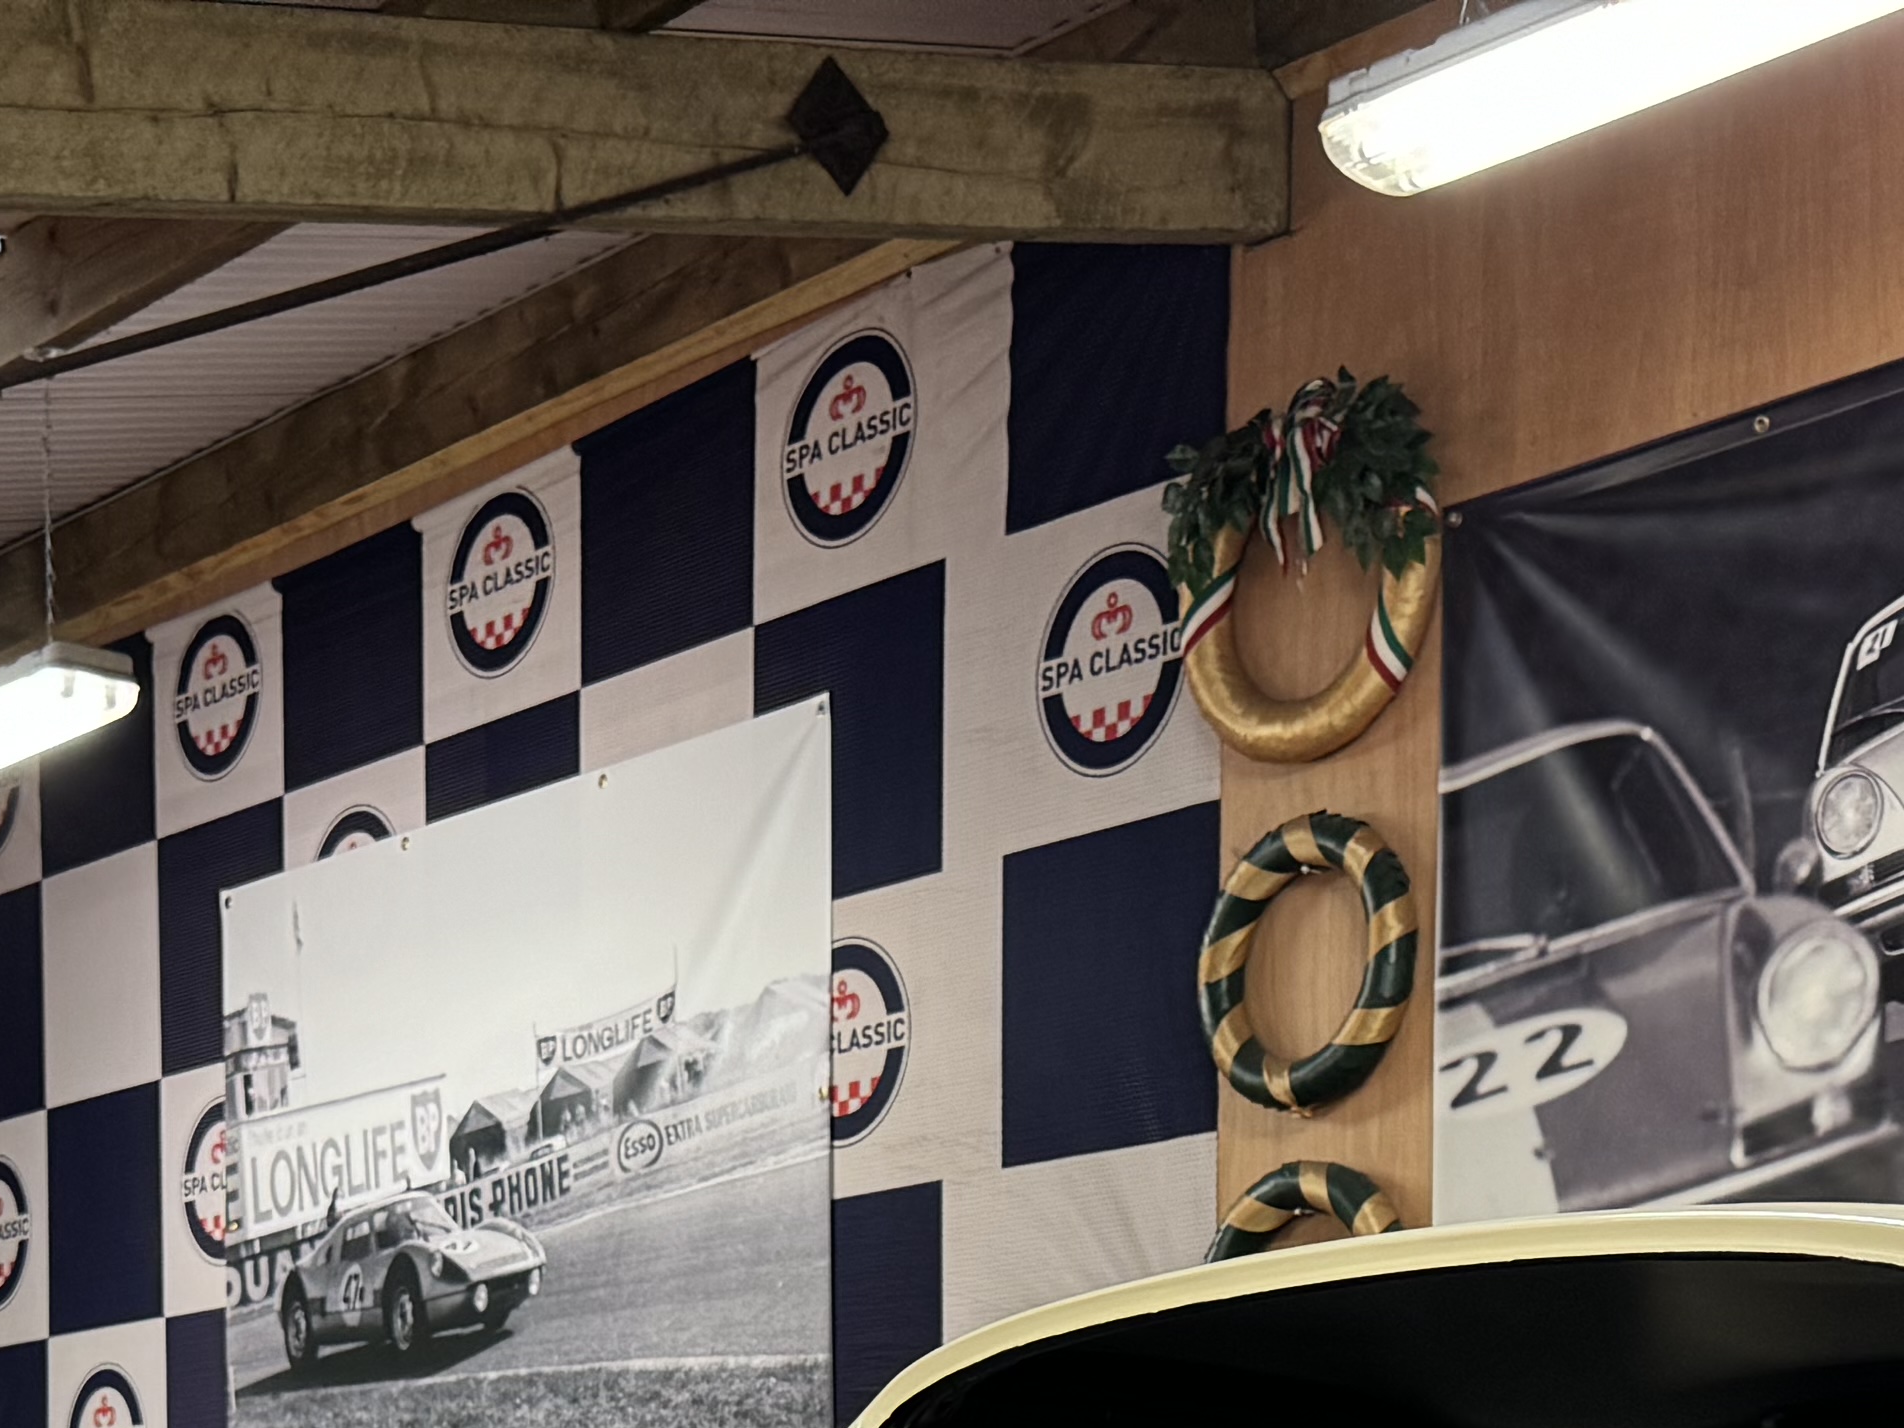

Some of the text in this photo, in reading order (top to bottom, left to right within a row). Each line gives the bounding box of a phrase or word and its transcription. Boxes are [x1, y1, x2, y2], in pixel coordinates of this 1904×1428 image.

[786, 403, 911, 473] SPA CLASSIC
[449, 551, 550, 610] SPA CLASSIC
[1041, 627, 1181, 691] SPA CLASSIC
[176, 669, 259, 719] SPA CLASSIC
[561, 1008, 653, 1061] LONGLIFE
[834, 1018, 905, 1054] LASSIC
[1438, 1024, 1594, 1109] 22
[665, 1113, 703, 1146] EXTRA
[184, 1175, 207, 1197] SPA
[251, 1101, 439, 1224] LONGLIFE BP
